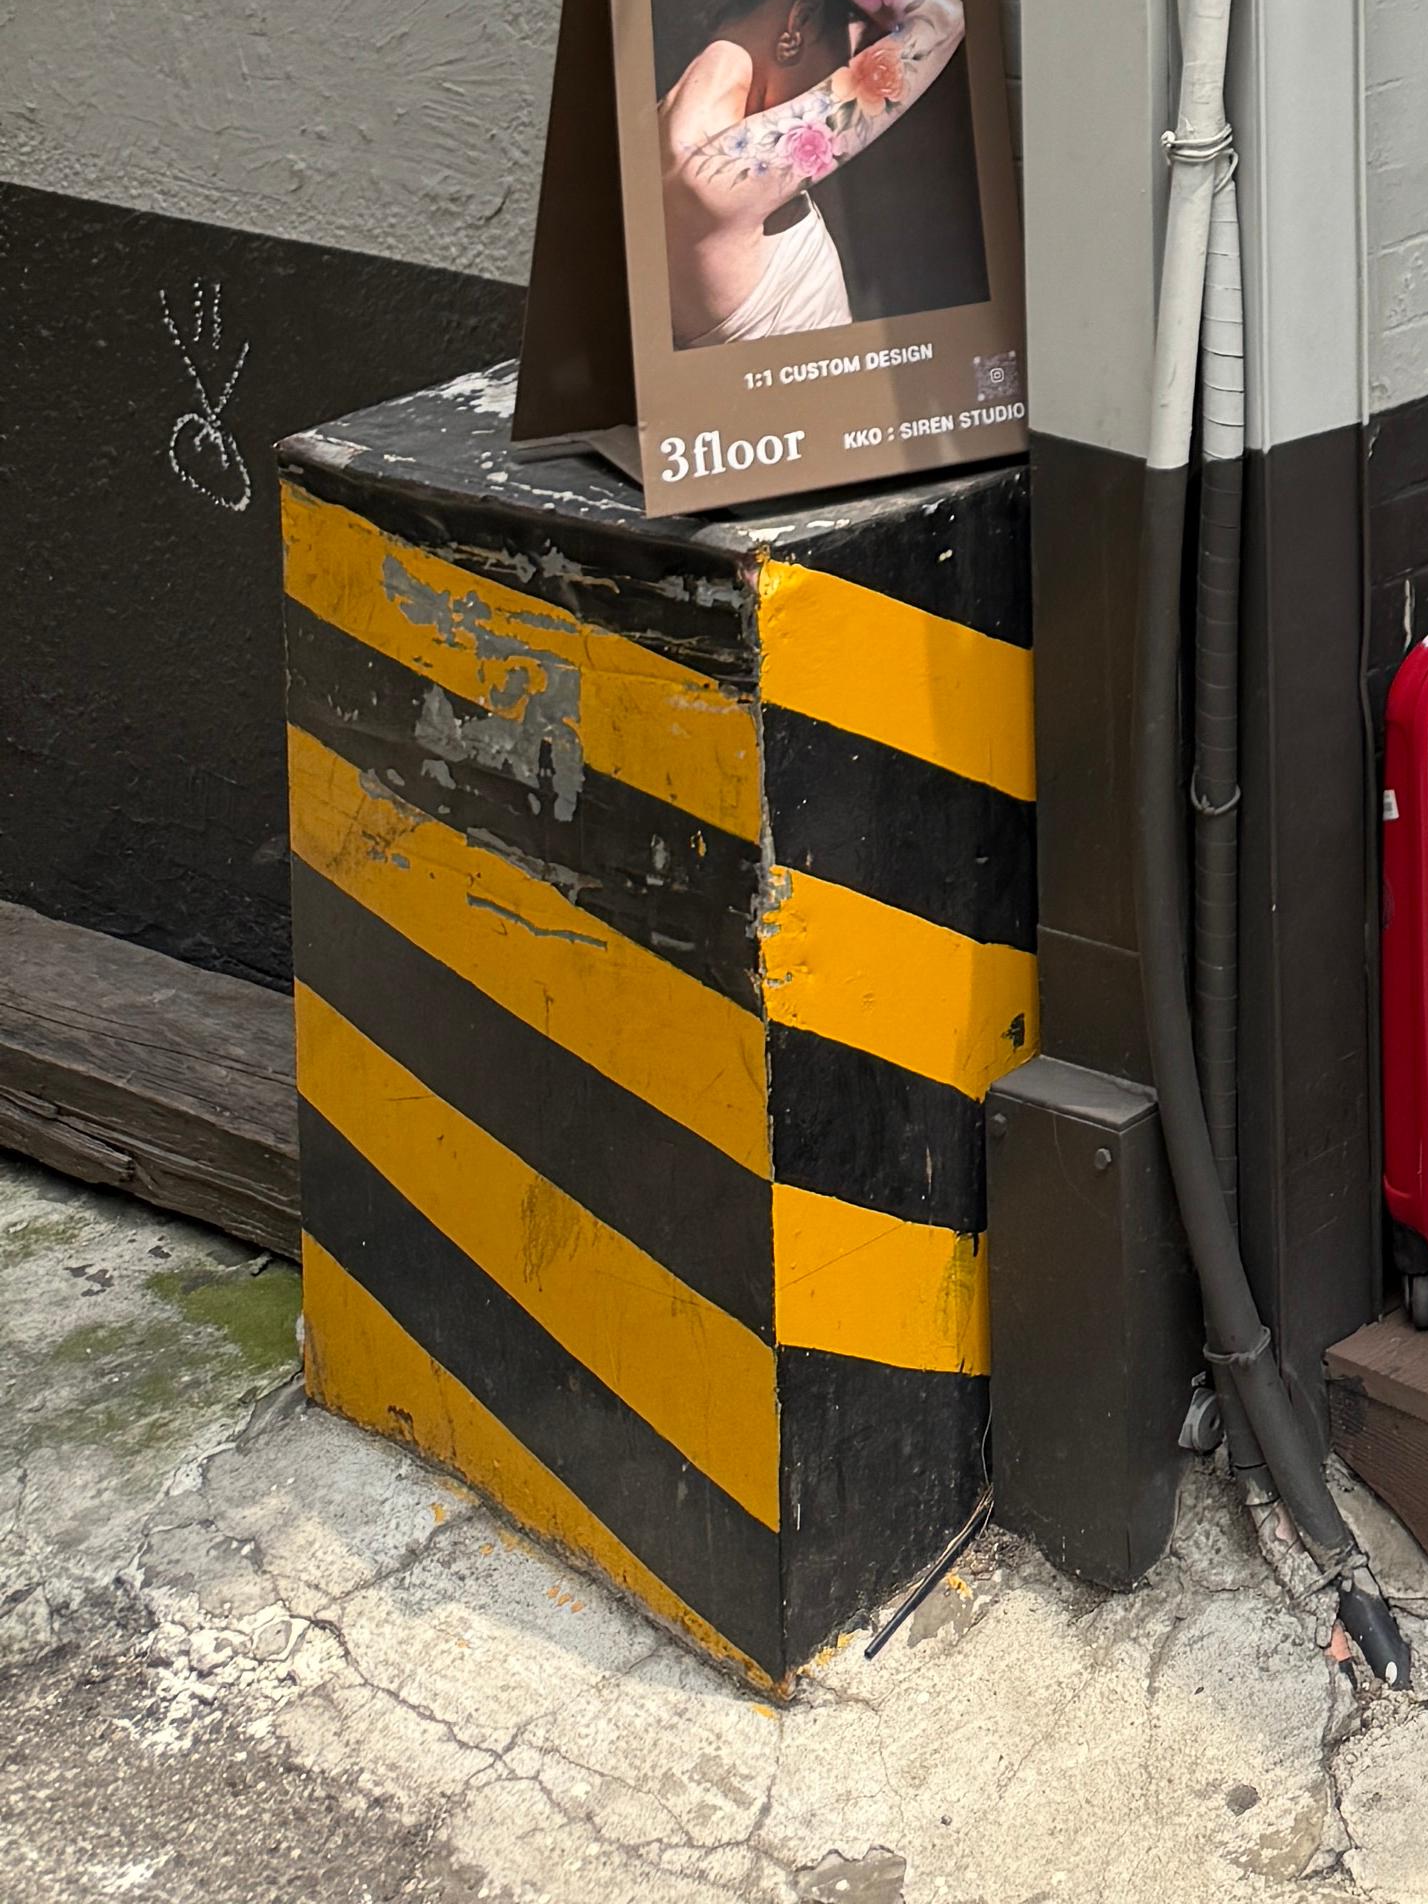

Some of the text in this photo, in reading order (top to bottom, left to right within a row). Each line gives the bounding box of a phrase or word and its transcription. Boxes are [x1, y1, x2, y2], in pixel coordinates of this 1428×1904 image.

[744, 342, 934, 392] 1:1 CUSTOM DESIGN
[844, 427, 883, 452] KKO
[900, 416, 954, 442] SIREN
[959, 401, 1026, 431] STUDIO
[660, 422, 806, 485] 3floor
